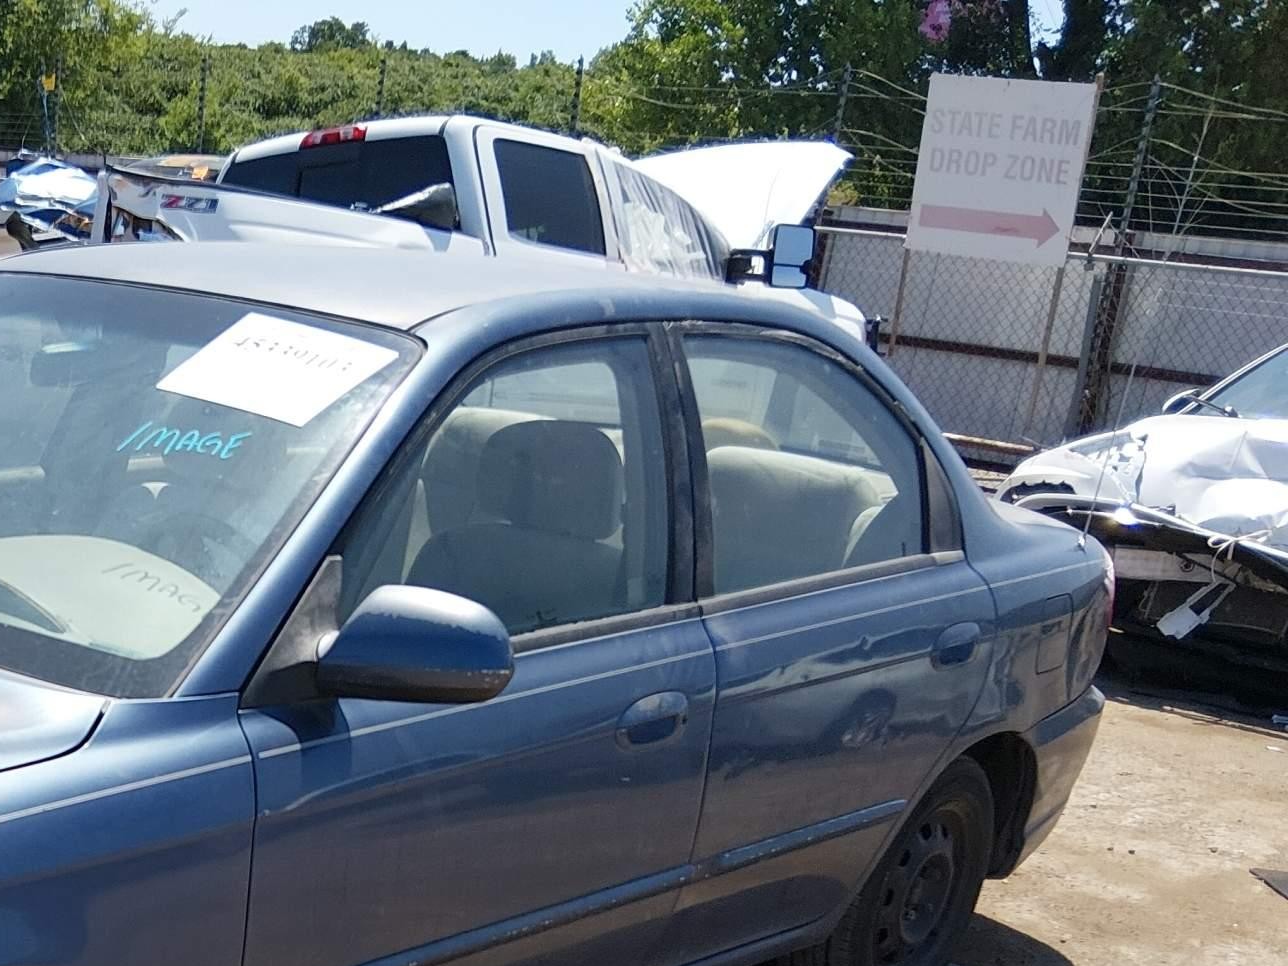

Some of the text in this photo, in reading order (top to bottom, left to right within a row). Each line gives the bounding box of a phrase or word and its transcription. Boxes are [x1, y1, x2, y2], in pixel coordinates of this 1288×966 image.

[930, 108, 1081, 147] STATE FARM
[929, 146, 1069, 186] DROP ZONE
[116, 421, 253, 459] IMAGE
